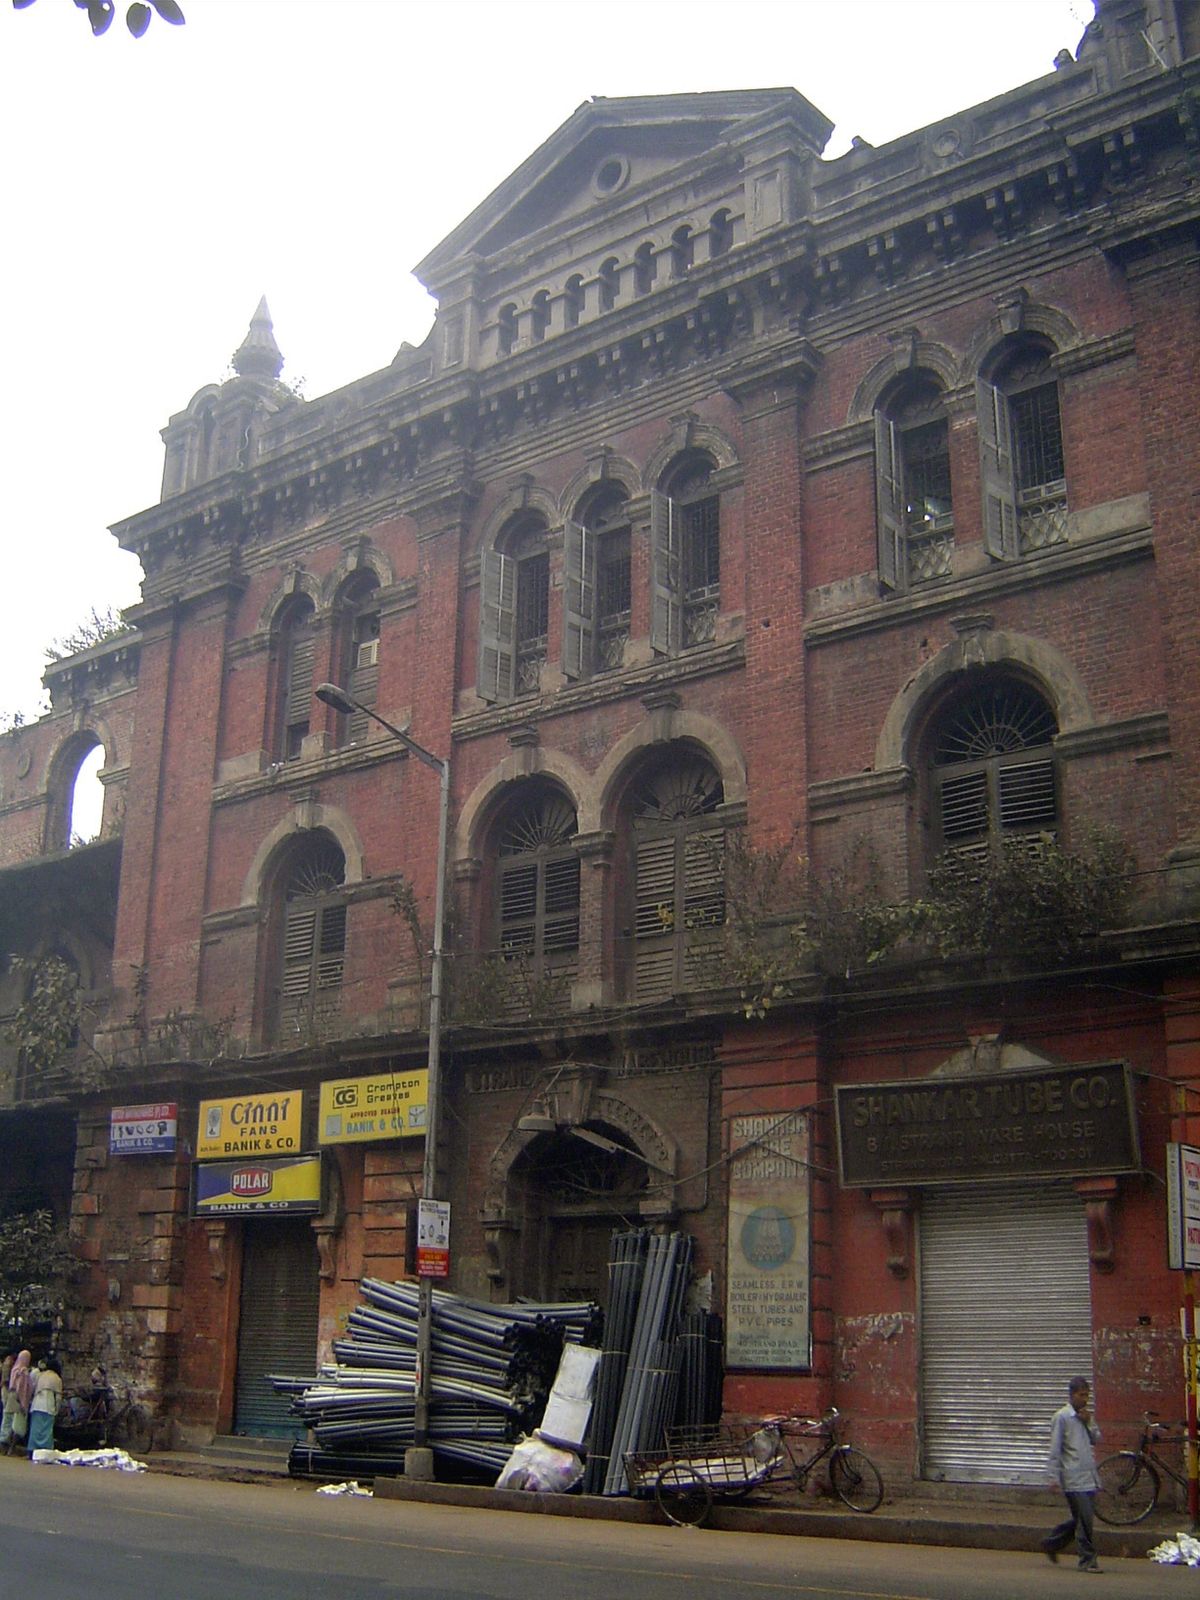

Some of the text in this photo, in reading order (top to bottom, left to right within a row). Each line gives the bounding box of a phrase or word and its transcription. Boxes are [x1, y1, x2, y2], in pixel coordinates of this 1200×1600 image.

[366, 1079, 421, 1094] Crompton
[335, 1088, 356, 1106] CG
[366, 1091, 411, 1104] Greaves
[853, 1075, 1118, 1128] SHANKAR TUBE CO.
[230, 1097, 290, 1125] Cinni
[240, 1125, 278, 1137] FANS
[345, 1120, 375, 1135] BANIK
[1033, 1120, 1096, 1141] HOUSE
[224, 1139, 262, 1153] BANIK
[264, 1138, 273, 1149] &
[276, 1137, 297, 1149] CO.
[233, 1173, 269, 1190] POLAR
[210, 1202, 251, 1211] BANIK
[255, 1201, 265, 1209] &
[732, 1304, 804, 1314] STEEL TUBES AND
[766, 1317, 793, 1327] PIPES
